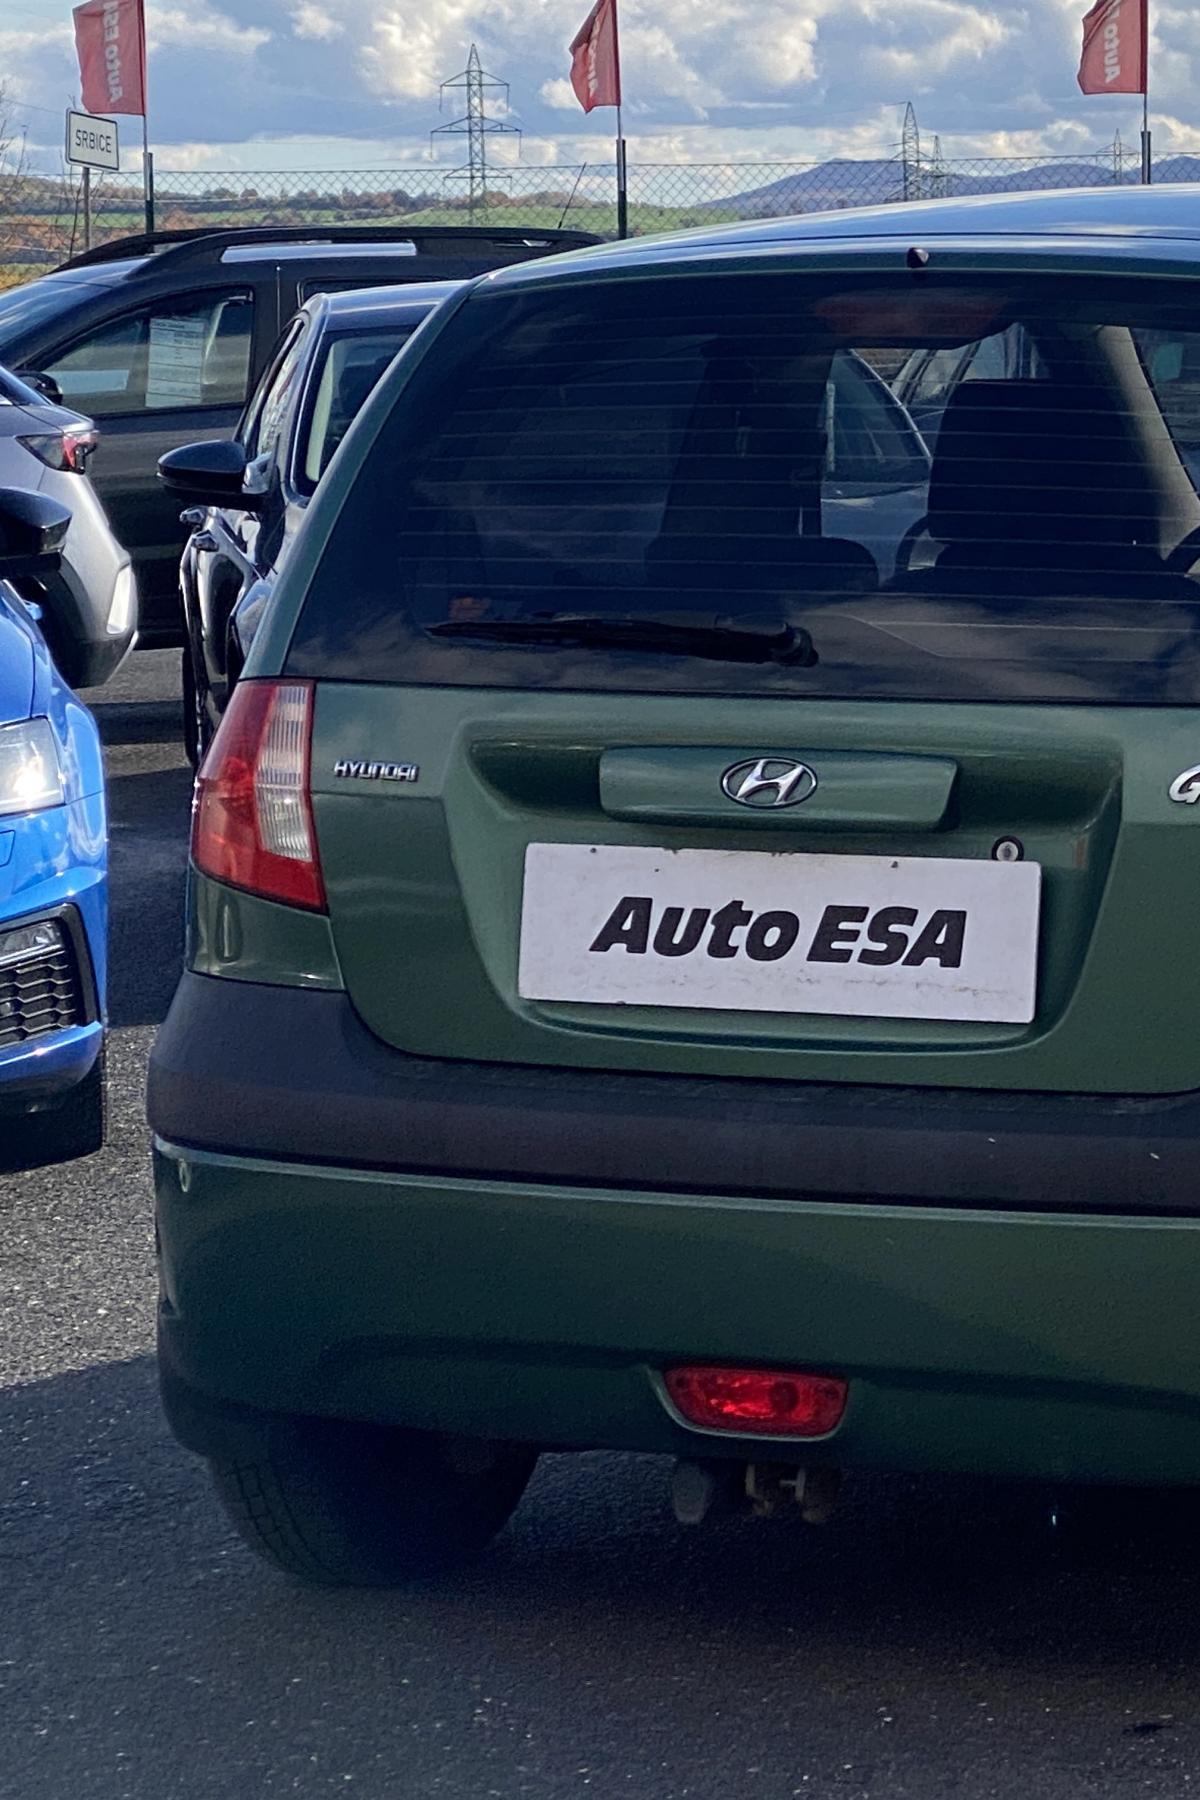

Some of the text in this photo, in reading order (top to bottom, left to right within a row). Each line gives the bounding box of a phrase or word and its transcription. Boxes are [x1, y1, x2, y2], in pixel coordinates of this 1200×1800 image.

[75, 129, 112, 153] SRBICE
[334, 760, 419, 782] HYUNDAI
[588, 895, 968, 969] Auto ESA
